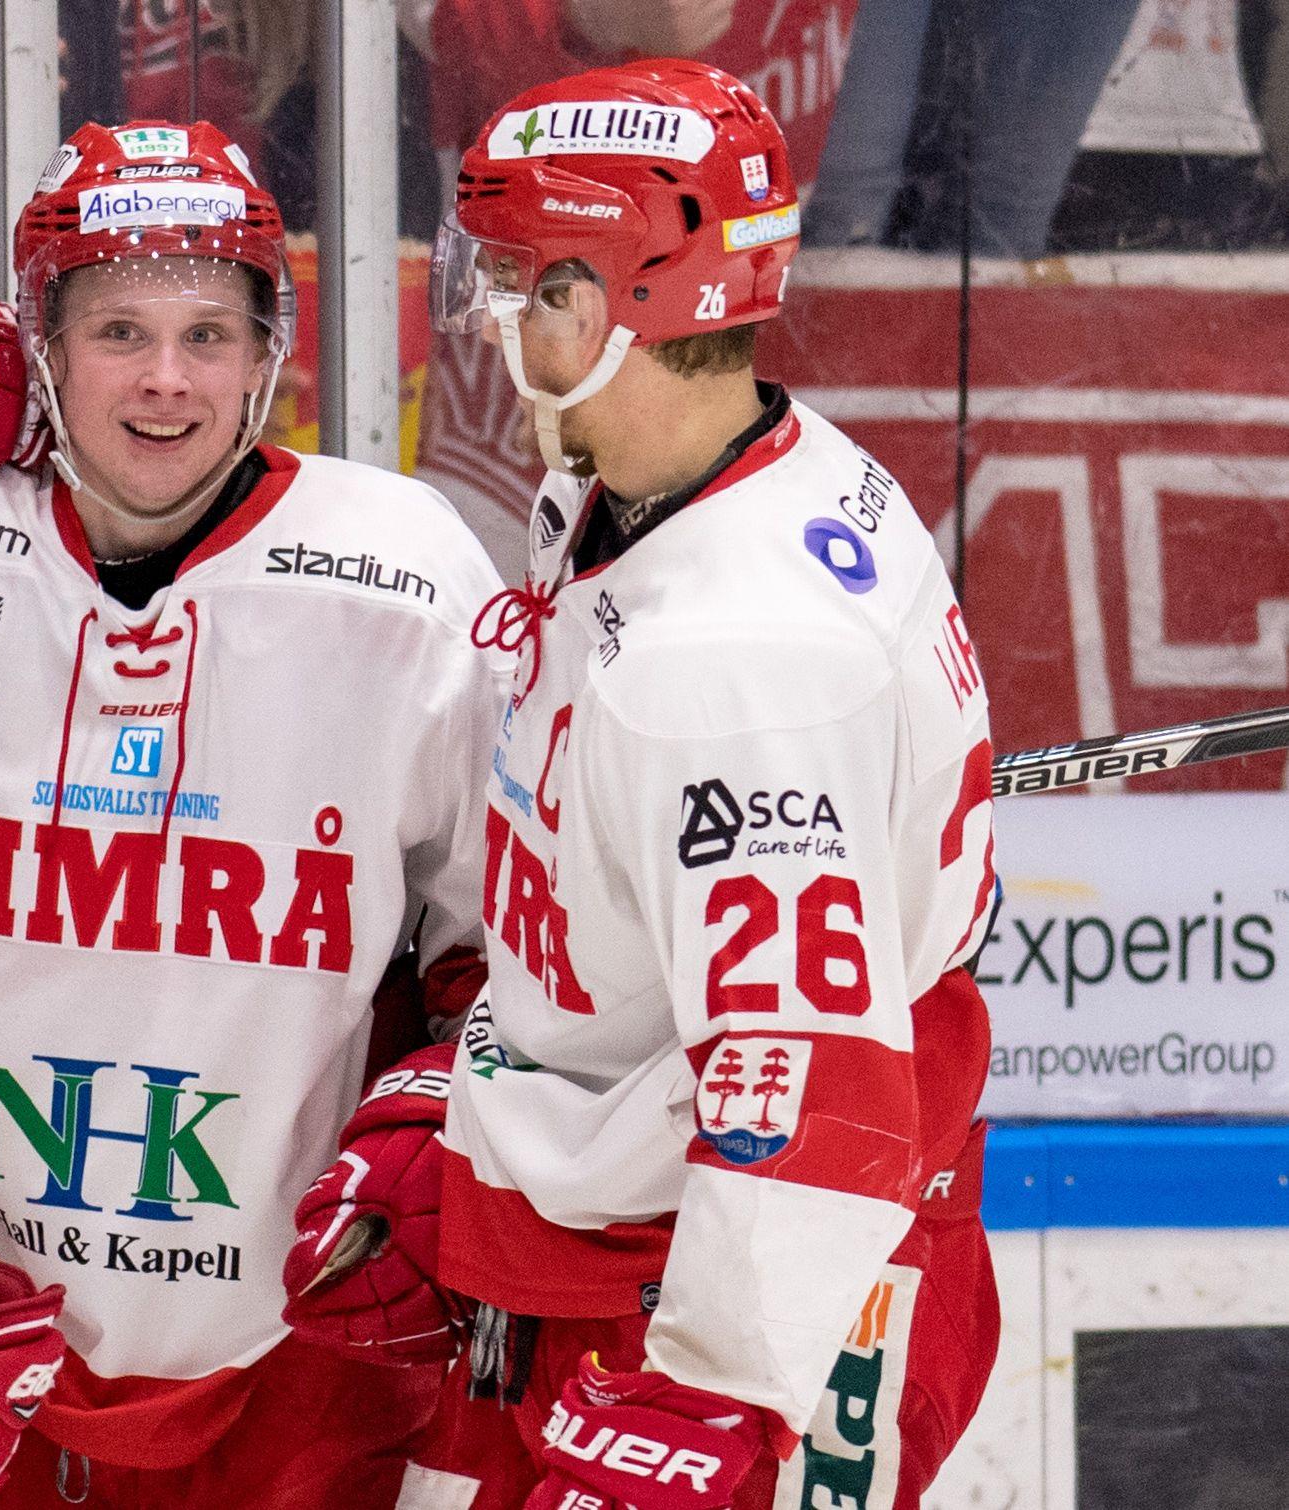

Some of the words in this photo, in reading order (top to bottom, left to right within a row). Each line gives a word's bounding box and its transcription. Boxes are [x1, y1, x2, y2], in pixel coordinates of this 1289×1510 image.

[549, 109, 681, 144] LILIUM
[549, 141, 677, 153] ASTIGHETER
[119, 165, 200, 178] BAUER
[542, 197, 623, 221] BAUER
[694, 282, 726, 321] 26
[265, 542, 436, 605] stadium
[115, 729, 160, 773] ST
[747, 789, 844, 834] SCA
[793, 835, 812, 858] of
[704, 873, 872, 1022] 26
[990, 1032, 1276, 1085] anpowerGroup
[57, 1226, 91, 1266] &
[103, 1231, 242, 1283] Kapell
